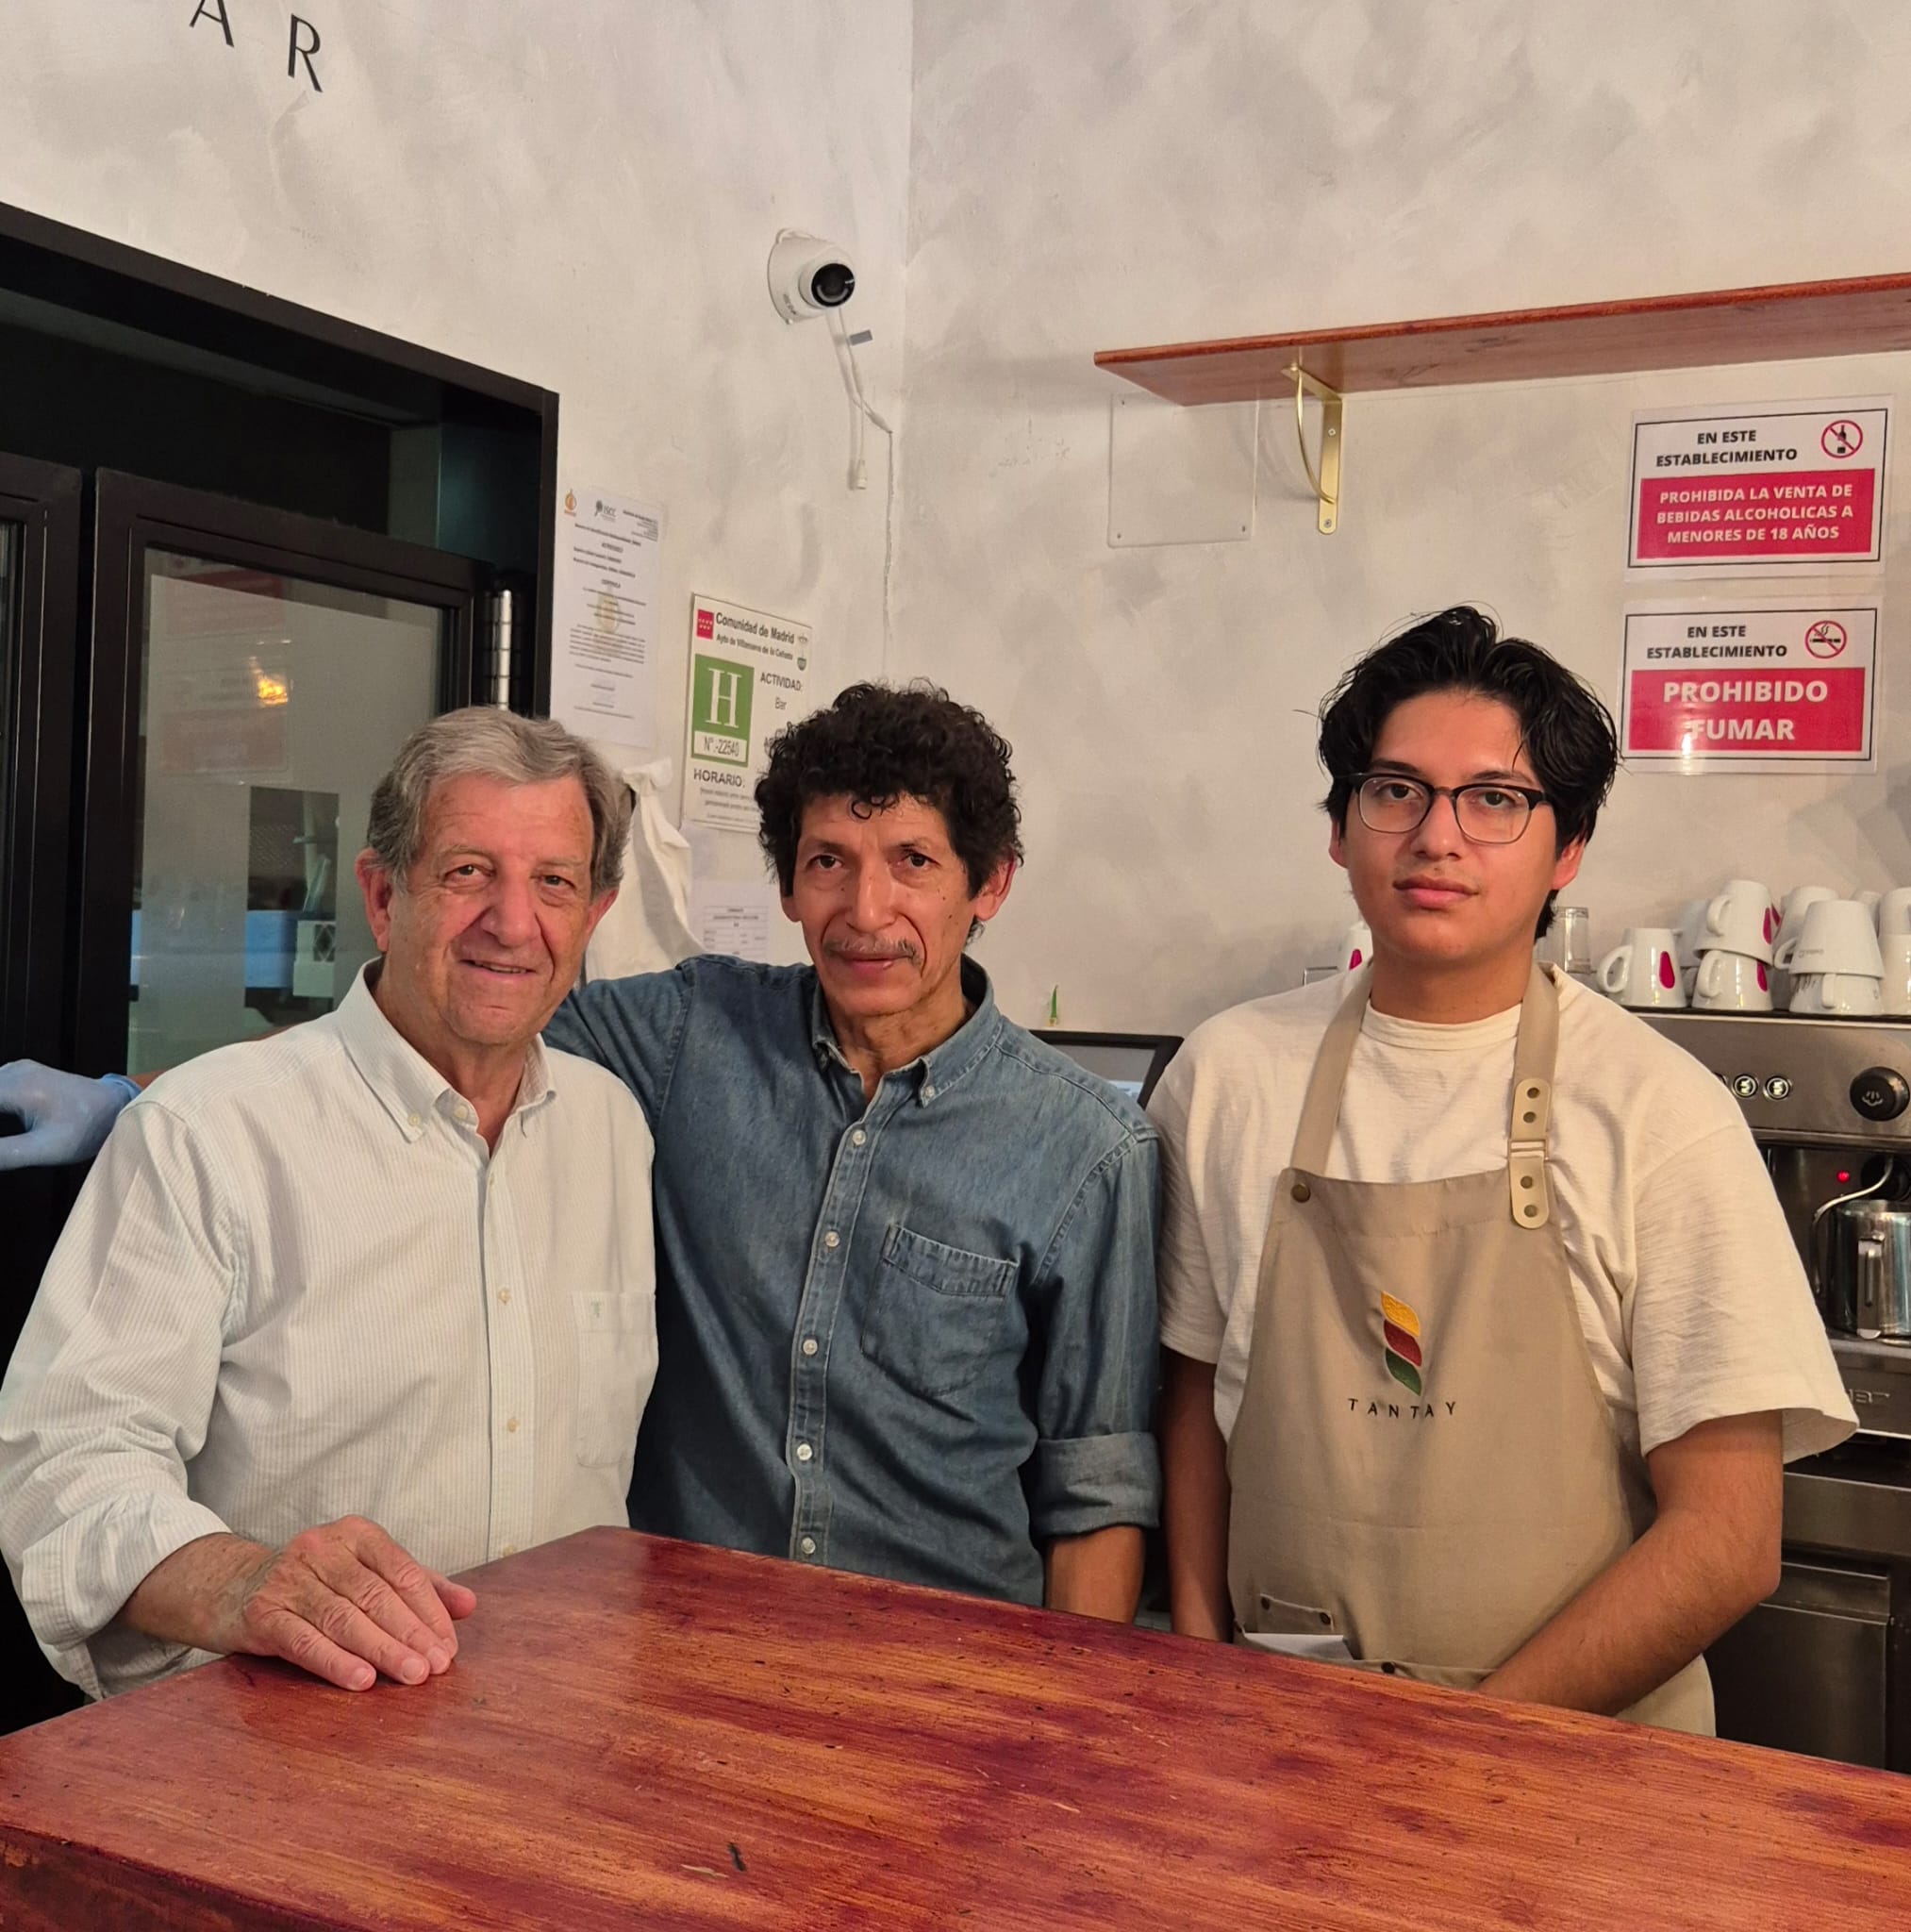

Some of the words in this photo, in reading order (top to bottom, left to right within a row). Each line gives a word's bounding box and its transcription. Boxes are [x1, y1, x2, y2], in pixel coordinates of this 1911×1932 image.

[1697, 432, 1718, 444] EN
[1721, 429, 1757, 443] ESTE
[1655, 448, 1798, 467] ESTABLECIMIENTO
[1659, 488, 1745, 505] PROHIBIDA
[1750, 487, 1770, 500] LA
[1773, 485, 1827, 499] VENTA
[1832, 484, 1853, 497] DE
[1656, 511, 1720, 525] BEBIDAS
[1724, 507, 1838, 522] ALCOHOLICAS
[1841, 506, 1853, 518] A
[1667, 529, 1742, 543] MENORES
[1746, 528, 1766, 541] DE
[1770, 527, 1788, 540] 18
[1792, 524, 1839, 540] AÑOS
[716, 611, 757, 634] Comunidad
[758, 625, 769, 638] de
[771, 627, 794, 644] Madrid
[1687, 626, 1707, 638] EN
[1712, 625, 1747, 637] ESTE
[1647, 645, 1787, 659] ESTABLECIMIENTO
[705, 668, 742, 728] H
[1663, 680, 1828, 703] PROHIBIDO
[774, 696, 787, 710] Bar
[1688, 719, 1796, 741] FUMAR
[1348, 1397, 1456, 1420] TANTAY
